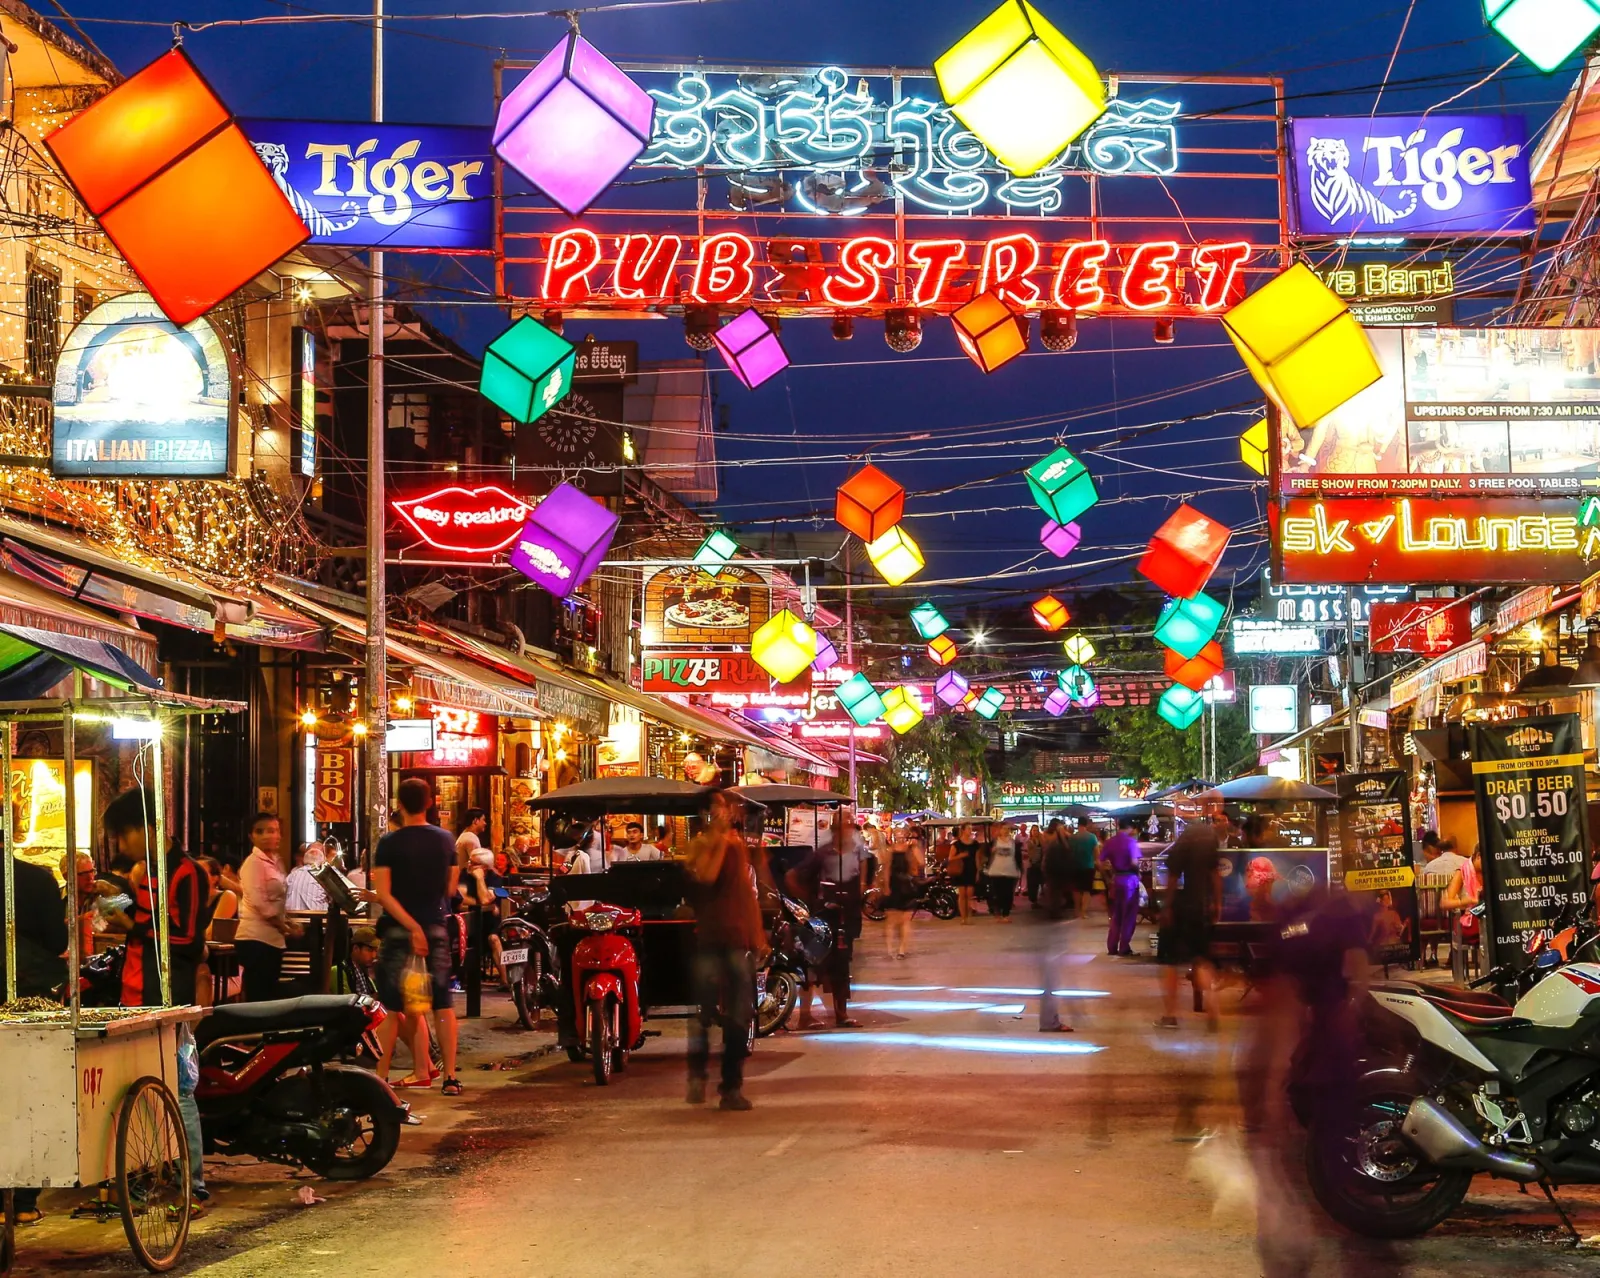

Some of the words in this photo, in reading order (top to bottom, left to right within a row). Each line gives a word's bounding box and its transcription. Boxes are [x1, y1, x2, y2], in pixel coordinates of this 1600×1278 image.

[1362, 127, 1521, 211] Tiger
[305, 138, 484, 226] Tiger
[542, 227, 755, 304] PUB
[821, 233, 1251, 312] STREET
[1364, 261, 1453, 295] Band
[1365, 306, 1412, 316] CAMBODIAN
[1414, 305, 1436, 314] FOOD
[1365, 314, 1393, 323] KHMER
[1395, 313, 1415, 322] CHEF
[1414, 406, 1465, 416] UPSTAIRS
[1467, 406, 1497, 416] OPEN
[1499, 406, 1530, 416] FROM
[1532, 406, 1553, 415] 7:30
[1554, 405, 1571, 415] AM
[66, 439, 147, 462] ITALIAN
[154, 439, 214, 461] PIZZA
[1291, 479, 1319, 489] FREE
[1321, 479, 1354, 489] SHOW
[1357, 479, 1389, 489] FROM
[1391, 479, 1428, 489] 7:30PM
[1430, 479, 1462, 489] DAILY.
[1469, 479, 1477, 489] 3
[1478, 479, 1505, 489] FREE
[1508, 479, 1536, 489] POOL
[1539, 479, 1581, 488] TABLES.
[413, 505, 450, 527] easy
[453, 505, 526, 528] speaking
[644, 657, 769, 686] PIZZERIA
[1505, 727, 1554, 746] TEMPLE
[1519, 744, 1541, 752] CLUB
[1497, 761, 1516, 770] FROM
[1545, 758, 1559, 766] 9PM
[320, 752, 345, 807] BBQ
[1355, 779, 1387, 792] TEMPLE
[1486, 778, 1533, 796] DRAFT
[1537, 774, 1574, 792] BEER
[1495, 790, 1568, 823] $0.50
[1506, 837, 1538, 846] WHISKEY
[1541, 835, 1559, 844] COKE
[1517, 829, 1547, 837] MEKONG
[1495, 851, 1518, 860] GLASS
[1520, 845, 1551, 858] $1.75
[1520, 858, 1546, 867] BUCKET
[1551, 851, 1582, 865] $5.00
[1505, 878, 1530, 886] VODKA
[1532, 876, 1547, 884] RED
[1499, 892, 1521, 901] GLASS
[1523, 885, 1555, 899] $2.00
[1524, 899, 1551, 908] BUCKET
[1554, 892, 1586, 906] $5.50
[1512, 921, 1530, 929] RUM
[1497, 935, 1520, 944] GLASS
